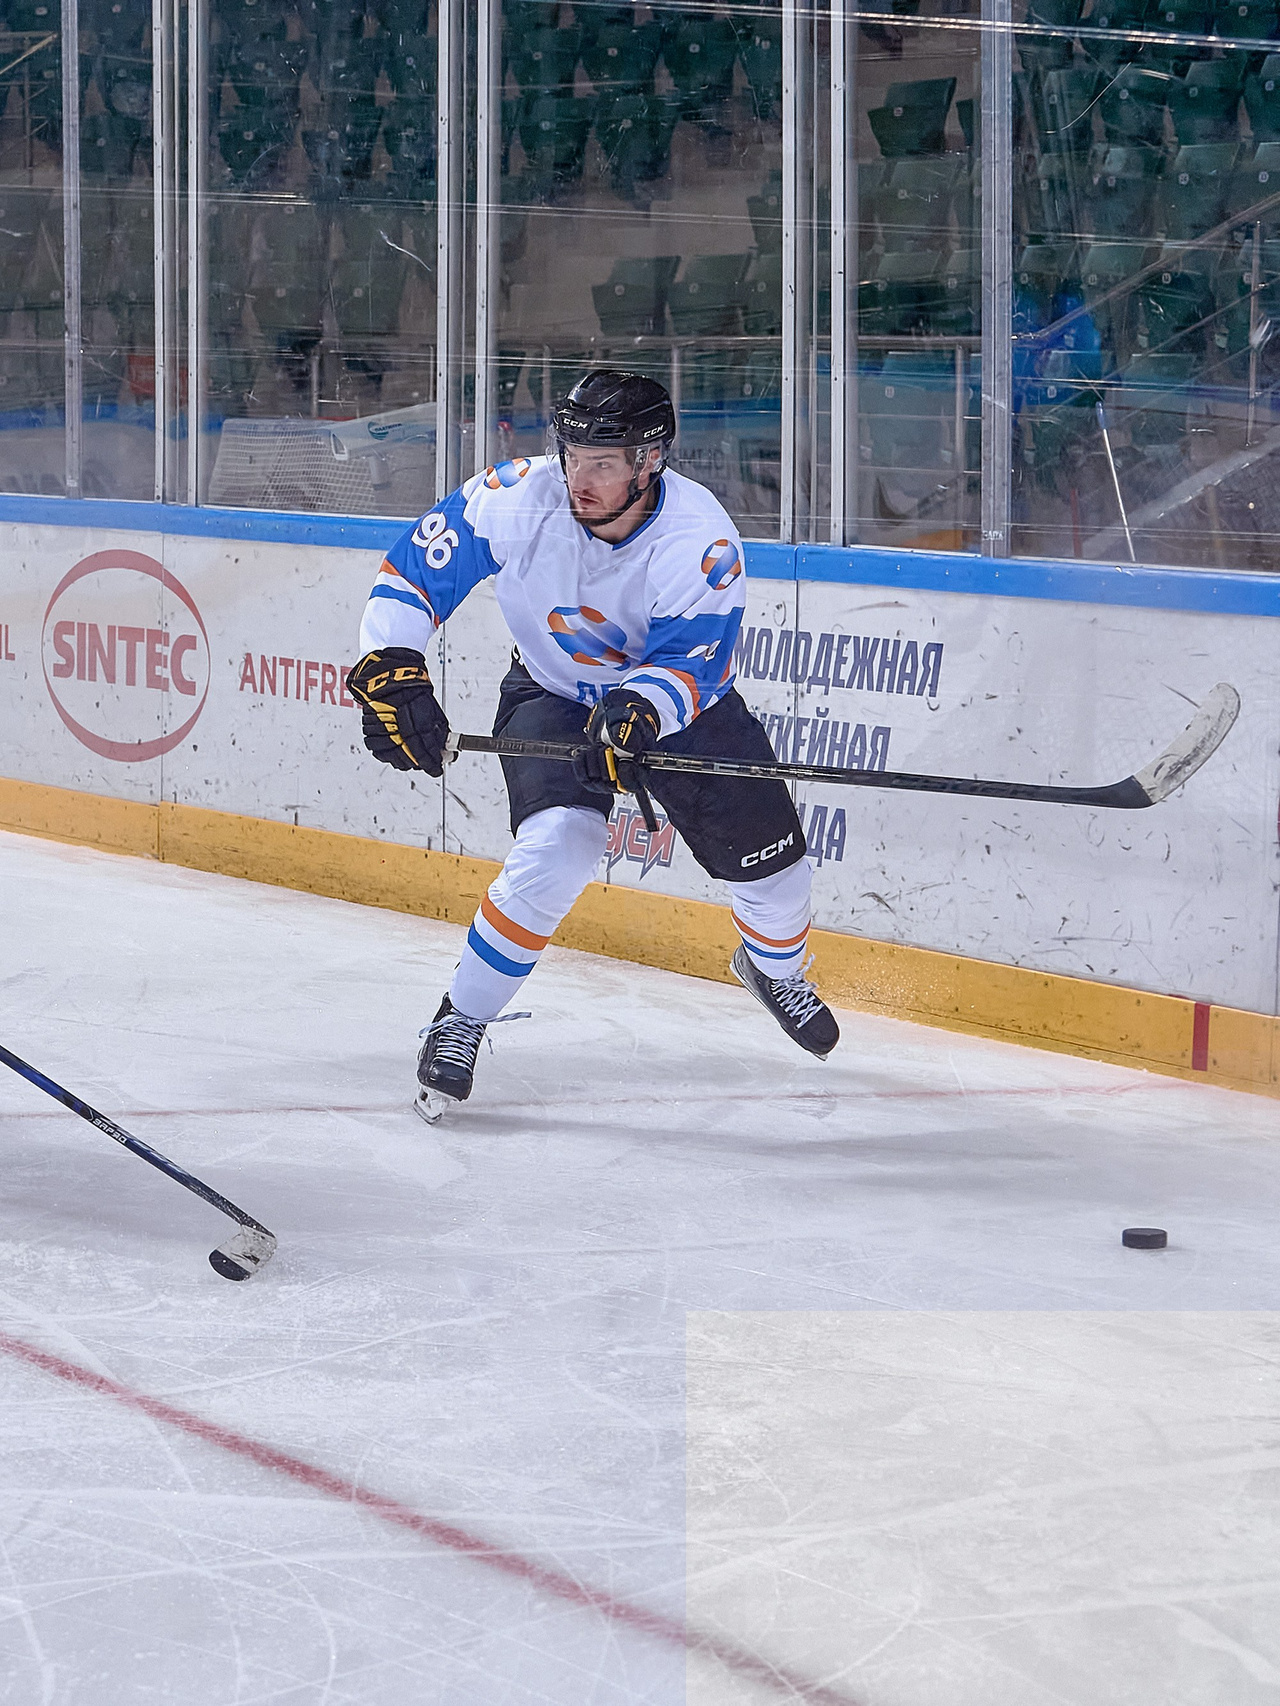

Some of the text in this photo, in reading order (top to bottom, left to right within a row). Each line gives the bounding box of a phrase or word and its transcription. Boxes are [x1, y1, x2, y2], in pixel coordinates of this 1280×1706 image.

[563, 418, 588, 429] CCM
[643, 424, 664, 438] CCM
[411, 512, 460, 570] 96
[53, 620, 198, 696] SINTEC
[239, 652, 364, 709] ANTIFRE
[734, 626, 944, 698] МОЛОДЕЖНАЯ
[605, 808, 677, 872] ЫСИ
[740, 831, 794, 869] CCM
